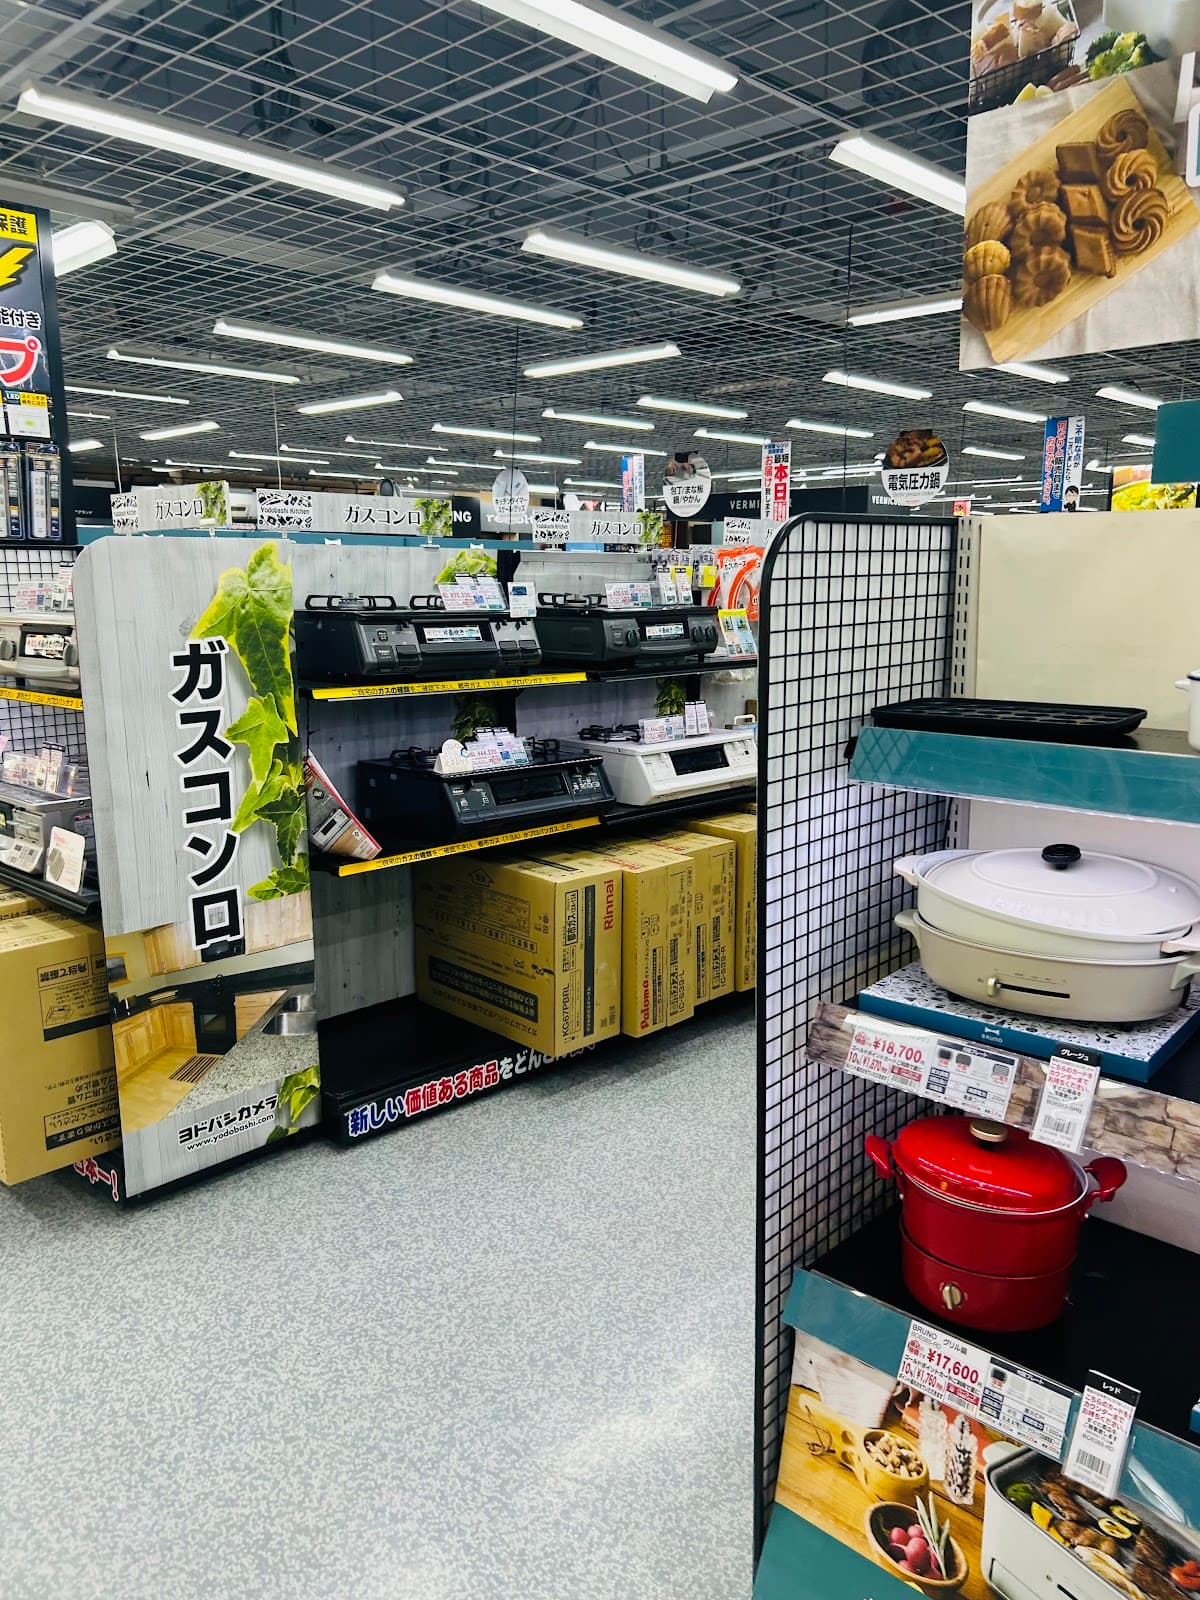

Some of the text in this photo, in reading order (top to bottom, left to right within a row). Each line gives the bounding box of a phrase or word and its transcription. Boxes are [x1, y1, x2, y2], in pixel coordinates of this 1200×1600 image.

[774, 464, 788, 500] 本日
[888, 472, 941, 491] 電気圧力鍋
[155, 499, 204, 520] ガスコンロ
[260, 506, 289, 514] Yodobashi
[344, 506, 422, 525] ガスコンロ
[590, 521, 642, 536] ガスコンロ
[173, 639, 242, 946] ガスコンロ
[604, 879, 614, 930] Rinnai
[641, 979, 650, 1030] Paloma
[873, 1037, 922, 1063] ¥18,700
[1061, 1049, 1089, 1061] グレージュ
[179, 1095, 278, 1144] ヨドバシカメラ
[187, 1114, 274, 1150] www.yodobashi.com
[912, 1323, 968, 1356] BRUNO グリル鍋
[901, 1360, 913, 1377] 10%
[926, 1348, 979, 1384] ¥17,600
[1102, 1381, 1121, 1395] レッド
[1083, 1401, 1126, 1424] カウンターまで
[1085, 1393, 1129, 1418] こちらのカードを
